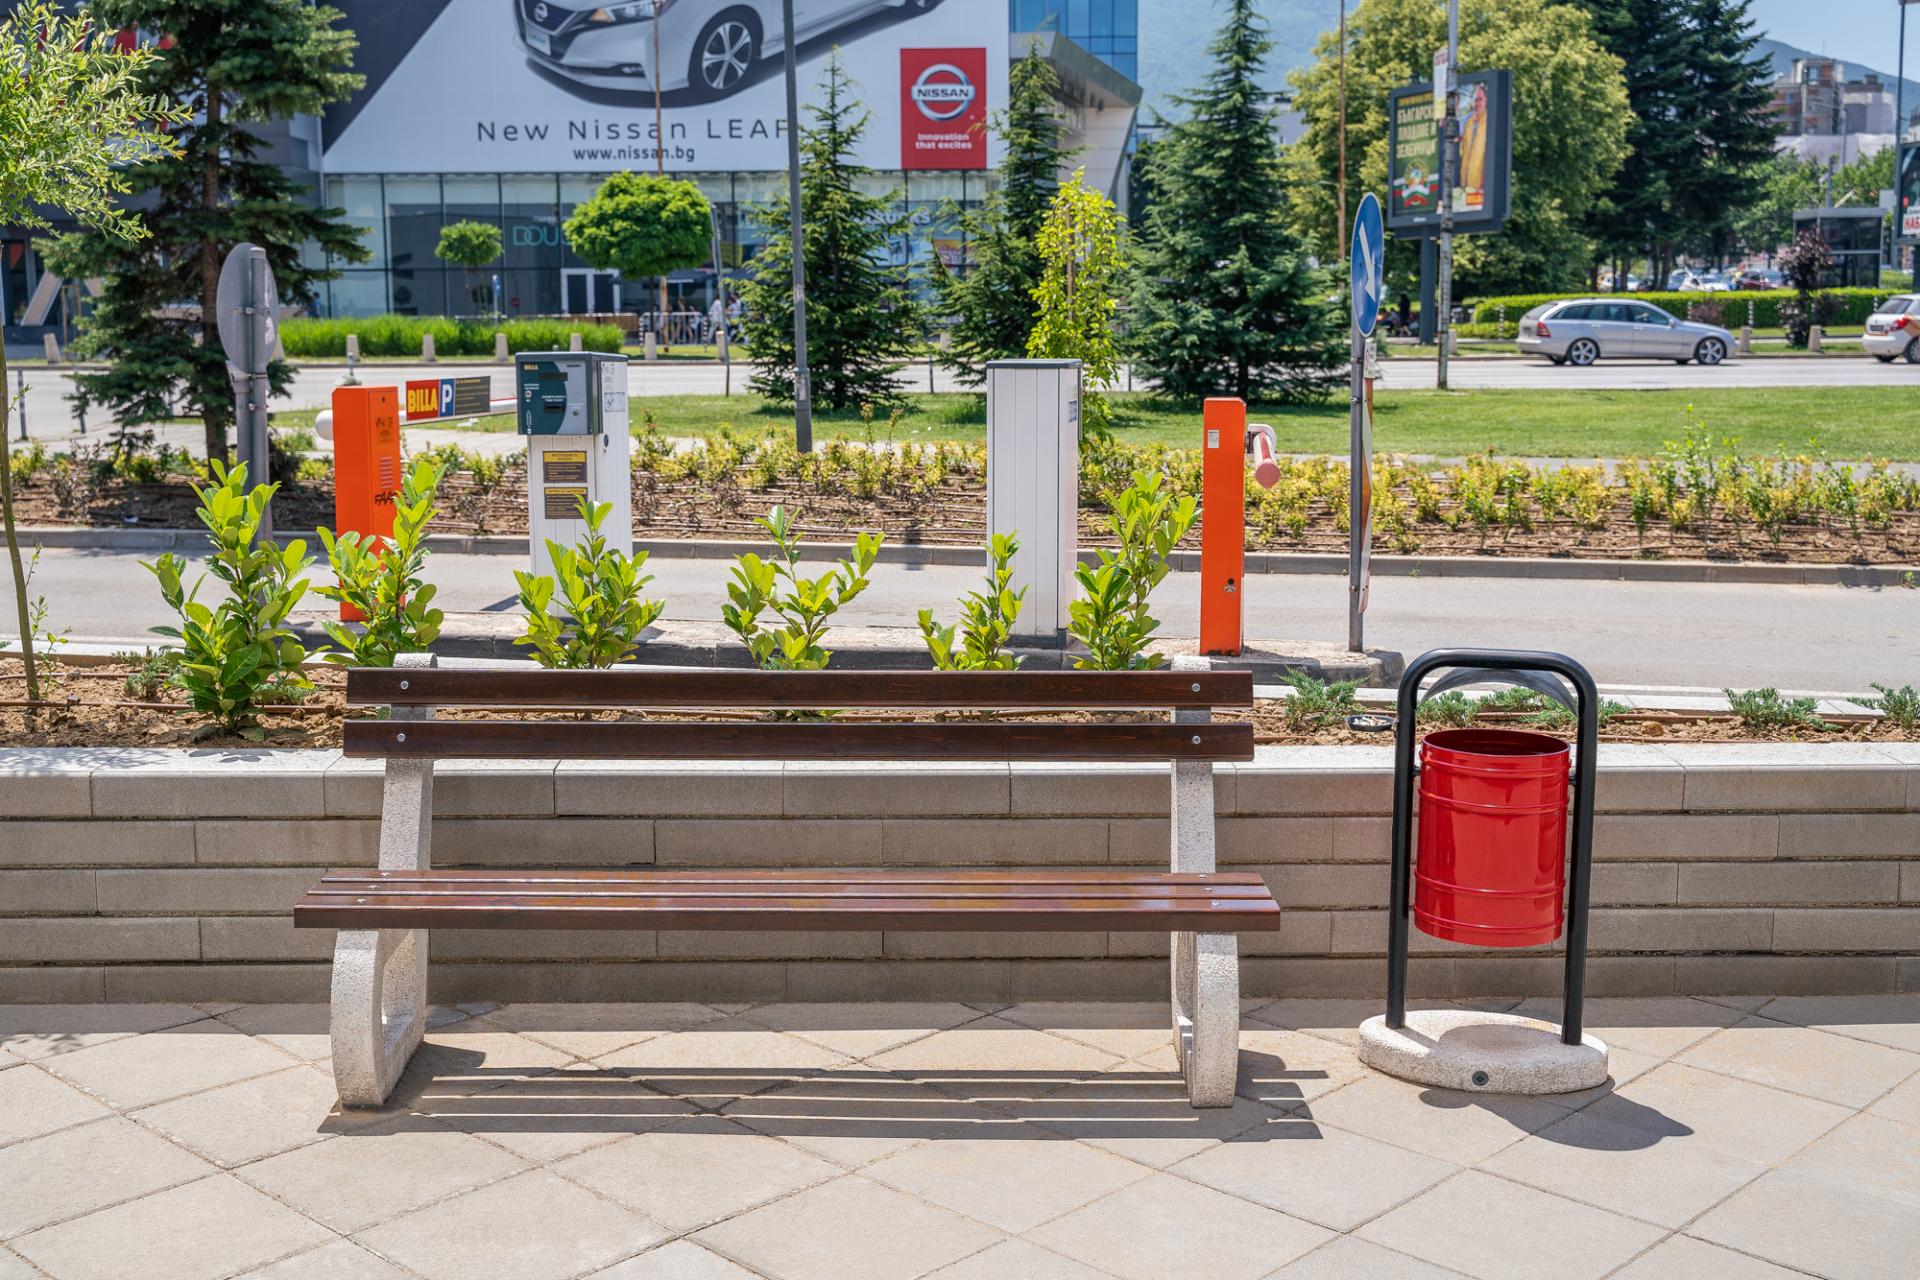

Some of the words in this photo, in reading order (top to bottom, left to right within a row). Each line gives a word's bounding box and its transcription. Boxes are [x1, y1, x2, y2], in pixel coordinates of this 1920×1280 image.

[917, 88, 969, 98] NISSAN
[477, 120, 549, 141] New
[568, 118, 687, 140] Nissan
[707, 118, 789, 139] LEAF
[917, 133, 970, 141] Innovation
[915, 141, 936, 150] that
[938, 141, 972, 150] excites
[573, 146, 695, 162] www.nissan.bg
[512, 225, 572, 247] DOU
[407, 388, 438, 413] BILLA
[441, 383, 453, 414] P
